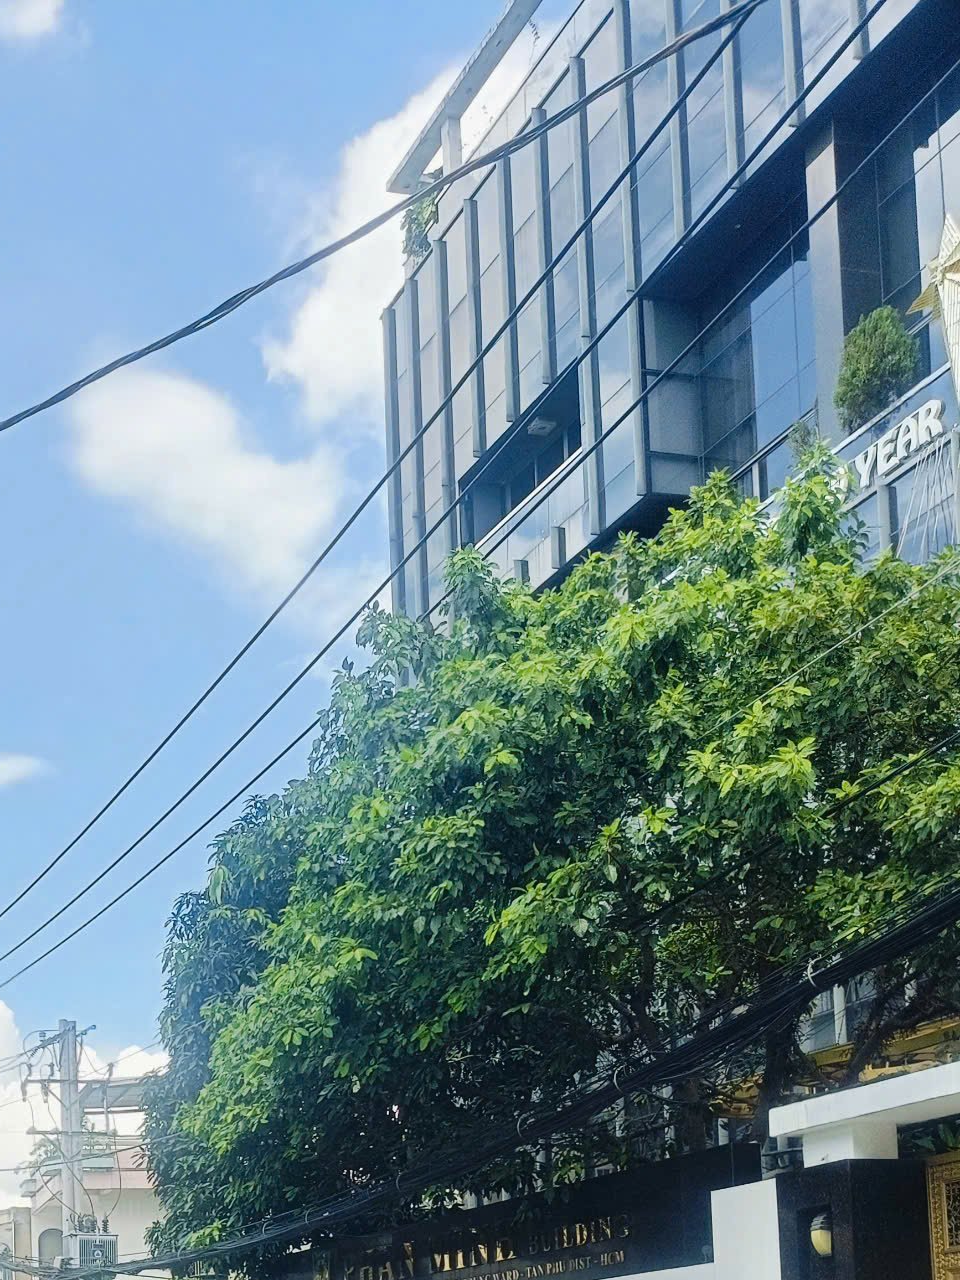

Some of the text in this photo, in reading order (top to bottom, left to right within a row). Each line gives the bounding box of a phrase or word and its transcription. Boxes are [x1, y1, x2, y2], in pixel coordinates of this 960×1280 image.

[850, 399, 946, 489] YEAR
[528, 1213, 631, 1256] BUILDING
[527, 1264, 546, 1279] TAN
[546, 1260, 567, 1275] PHU
[600, 1250, 625, 1266] HCM
